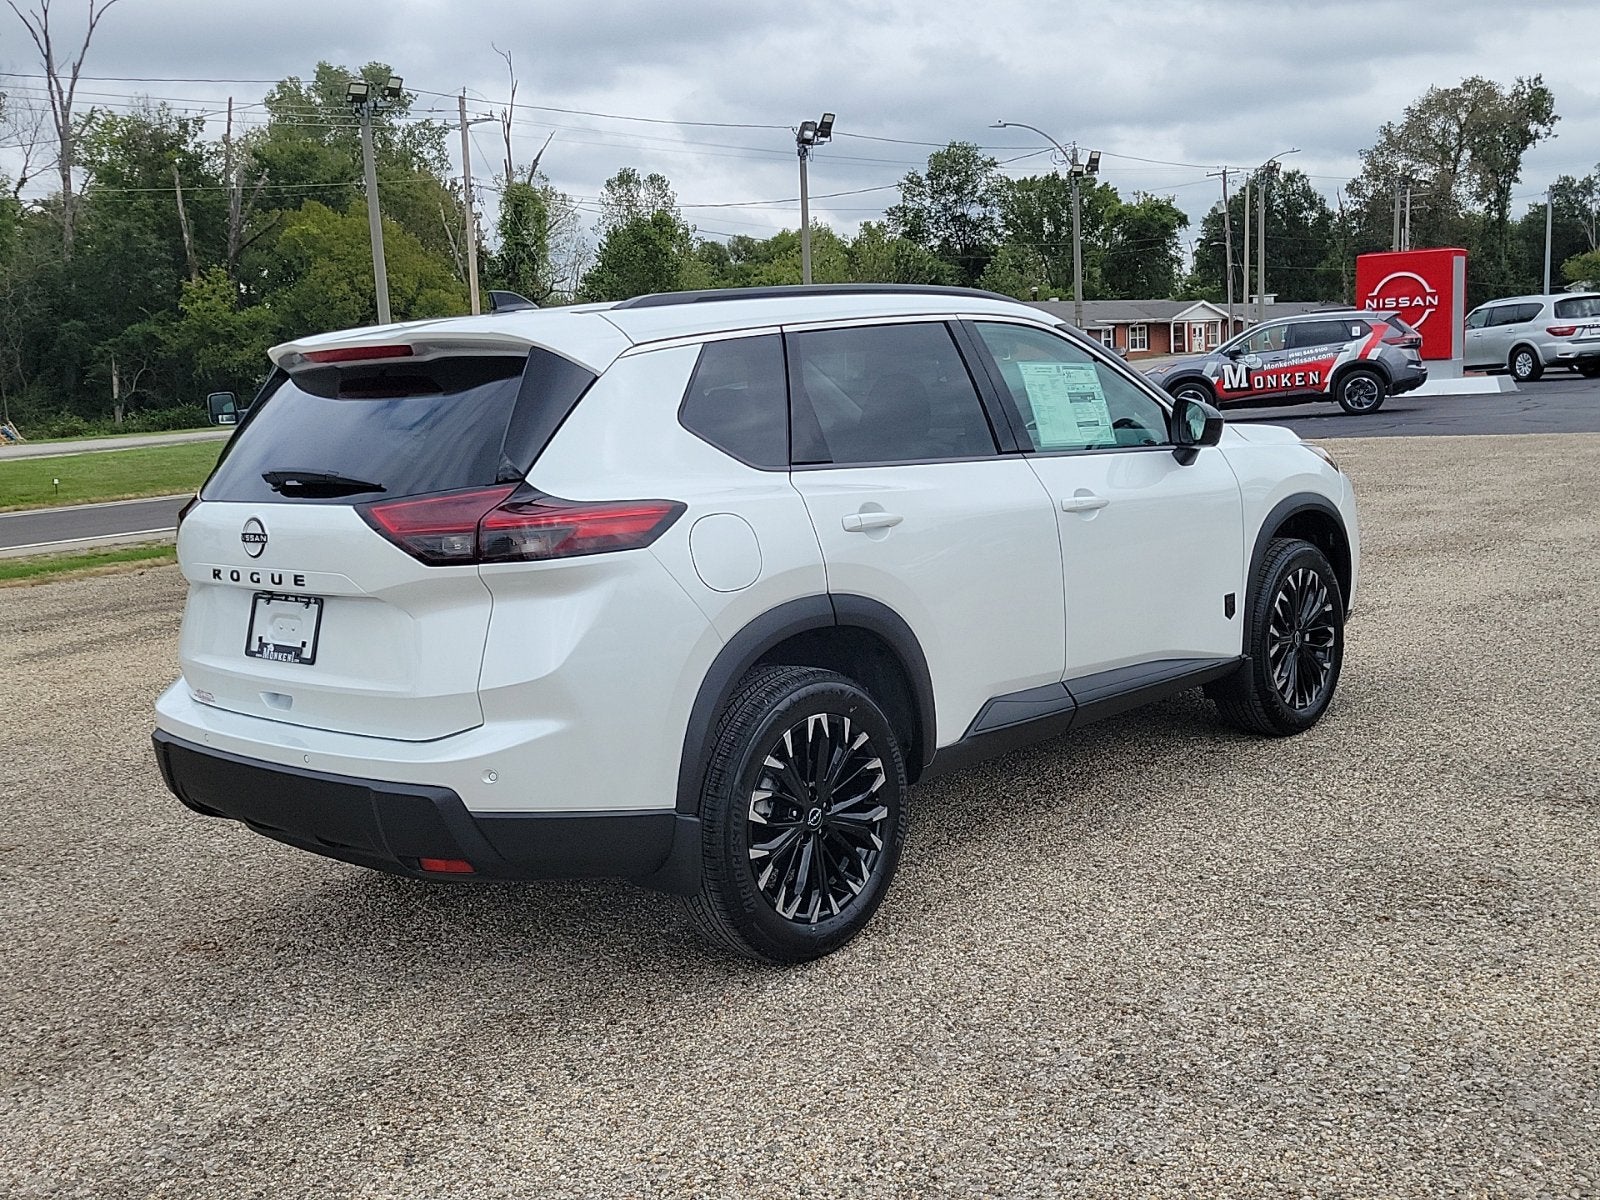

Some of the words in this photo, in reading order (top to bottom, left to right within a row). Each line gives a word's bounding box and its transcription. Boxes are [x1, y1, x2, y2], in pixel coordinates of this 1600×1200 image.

[1366, 295, 1439, 309] NISSAN
[1263, 352, 1335, 371] MonkenNissan.com
[212, 568, 306, 587] ROGUE
[887, 736, 908, 849] BRIDGESTONE
